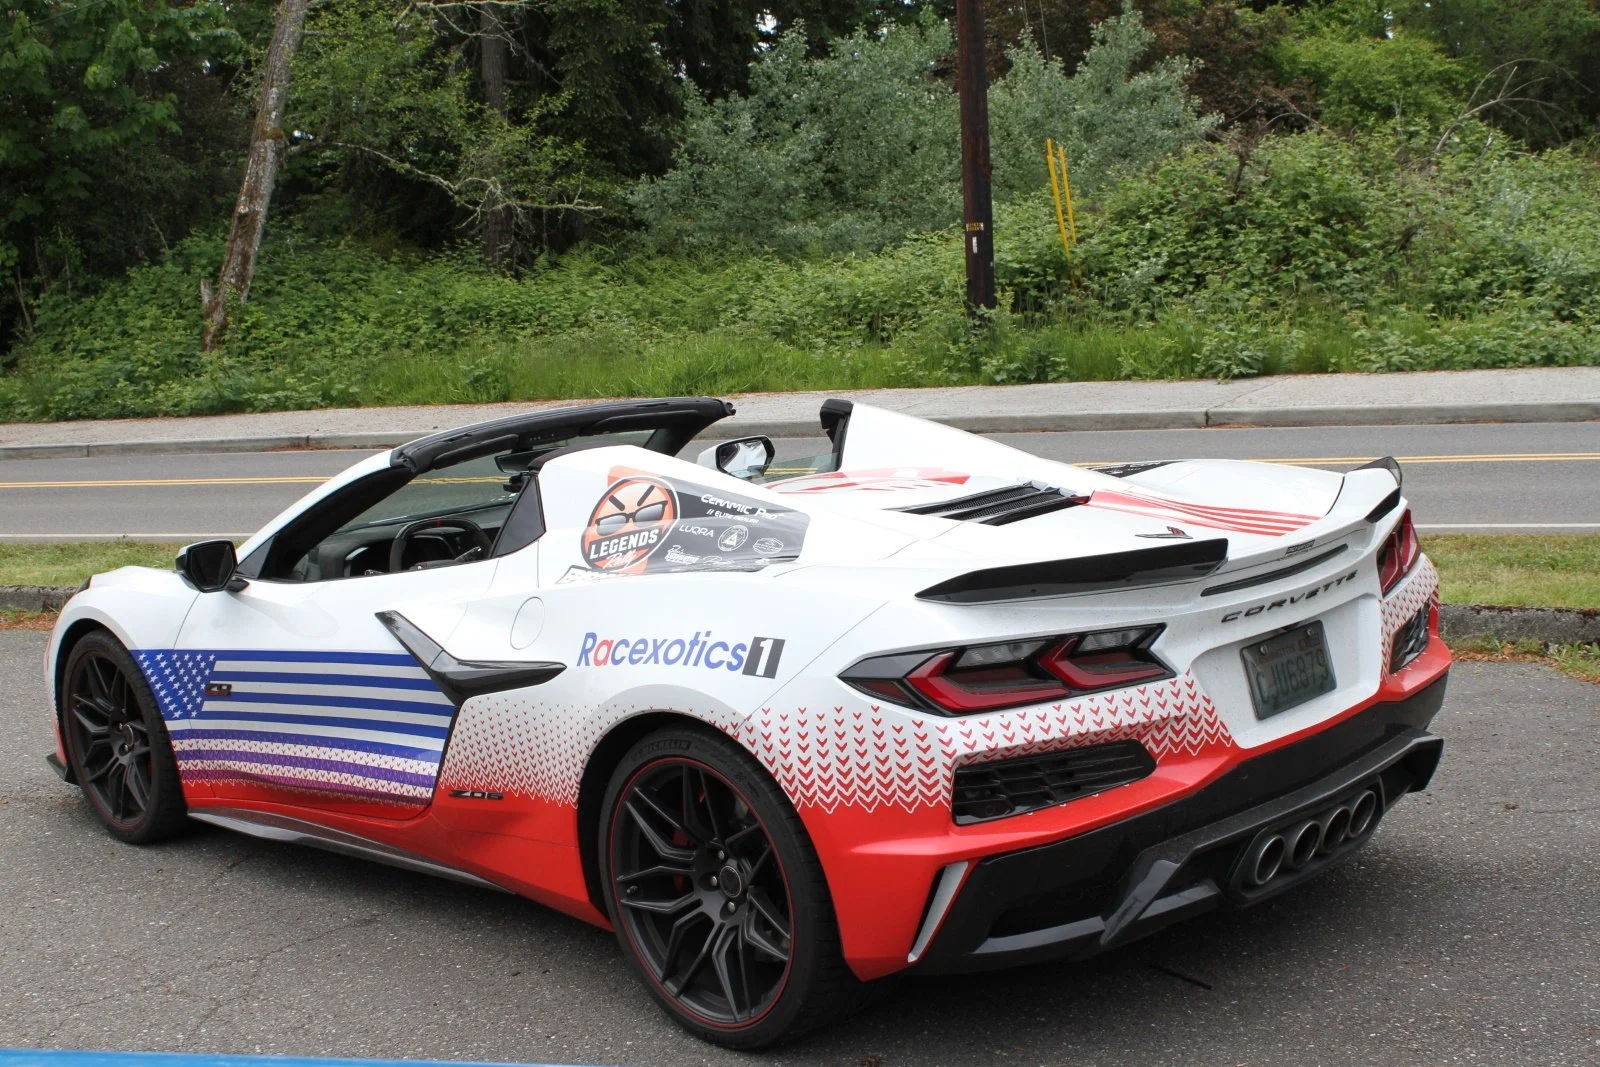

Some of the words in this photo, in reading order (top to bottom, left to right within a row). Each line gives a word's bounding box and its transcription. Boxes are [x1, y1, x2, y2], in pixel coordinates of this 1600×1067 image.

[589, 529, 660, 560] LEGENDS
[679, 524, 715, 538] LUQRA
[1221, 569, 1358, 623] CORVETTE
[1256, 648, 1330, 704] CJU6879
